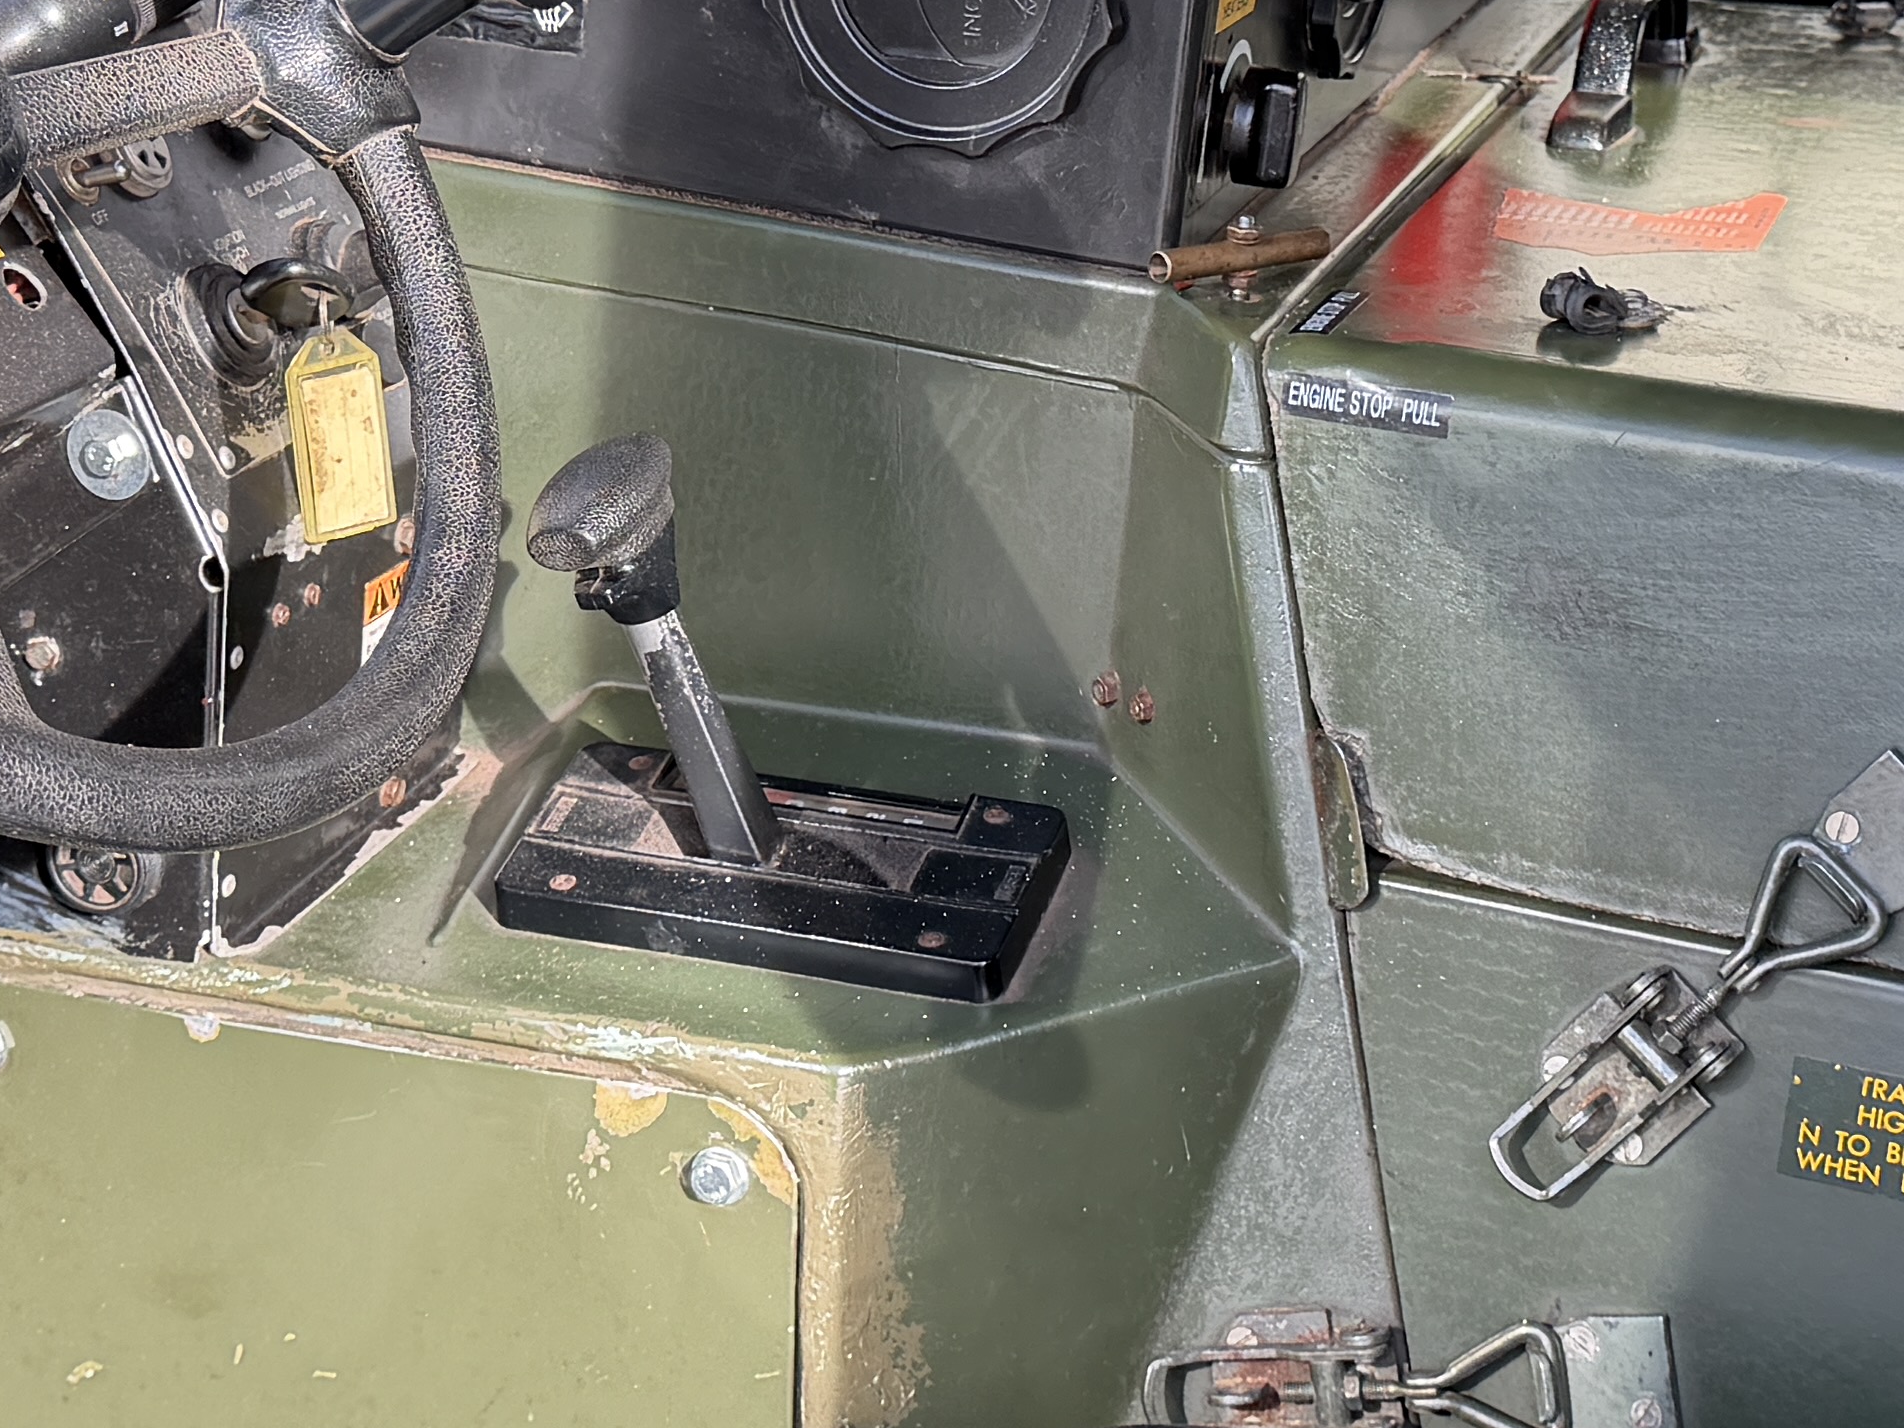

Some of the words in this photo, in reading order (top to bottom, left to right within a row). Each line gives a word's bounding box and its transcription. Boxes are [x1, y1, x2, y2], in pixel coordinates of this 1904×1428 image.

[1288, 381, 1345, 413] ENGINE
[1349, 391, 1393, 419] STOP
[1400, 397, 1441, 427] PULL
[1798, 1120, 1822, 1147] N
[1835, 1130, 1871, 1157] TO
[1796, 1147, 1881, 1187] WHEN
